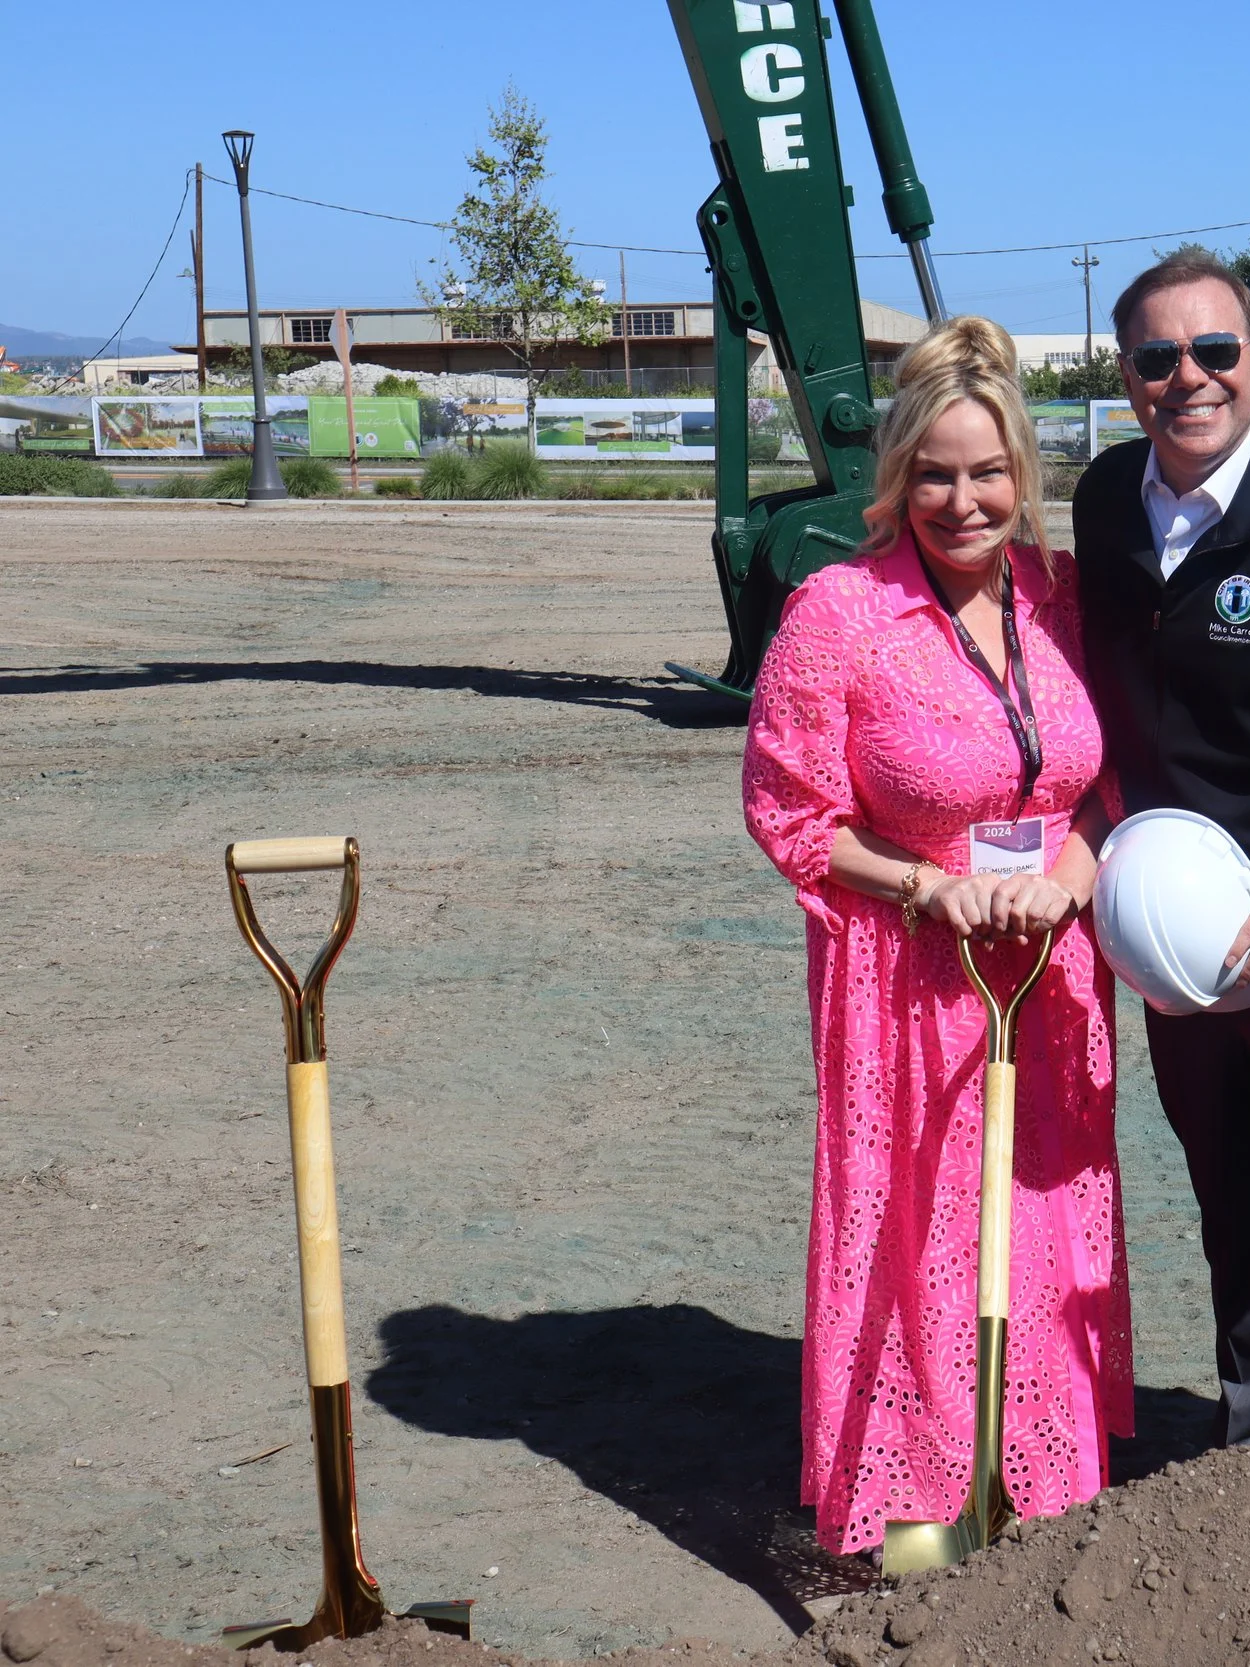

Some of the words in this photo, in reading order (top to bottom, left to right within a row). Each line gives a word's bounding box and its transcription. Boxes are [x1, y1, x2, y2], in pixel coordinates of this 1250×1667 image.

[1218, 580, 1231, 596] CITY
[1209, 622, 1228, 633] Mike
[984, 827, 1012, 837] 2024
